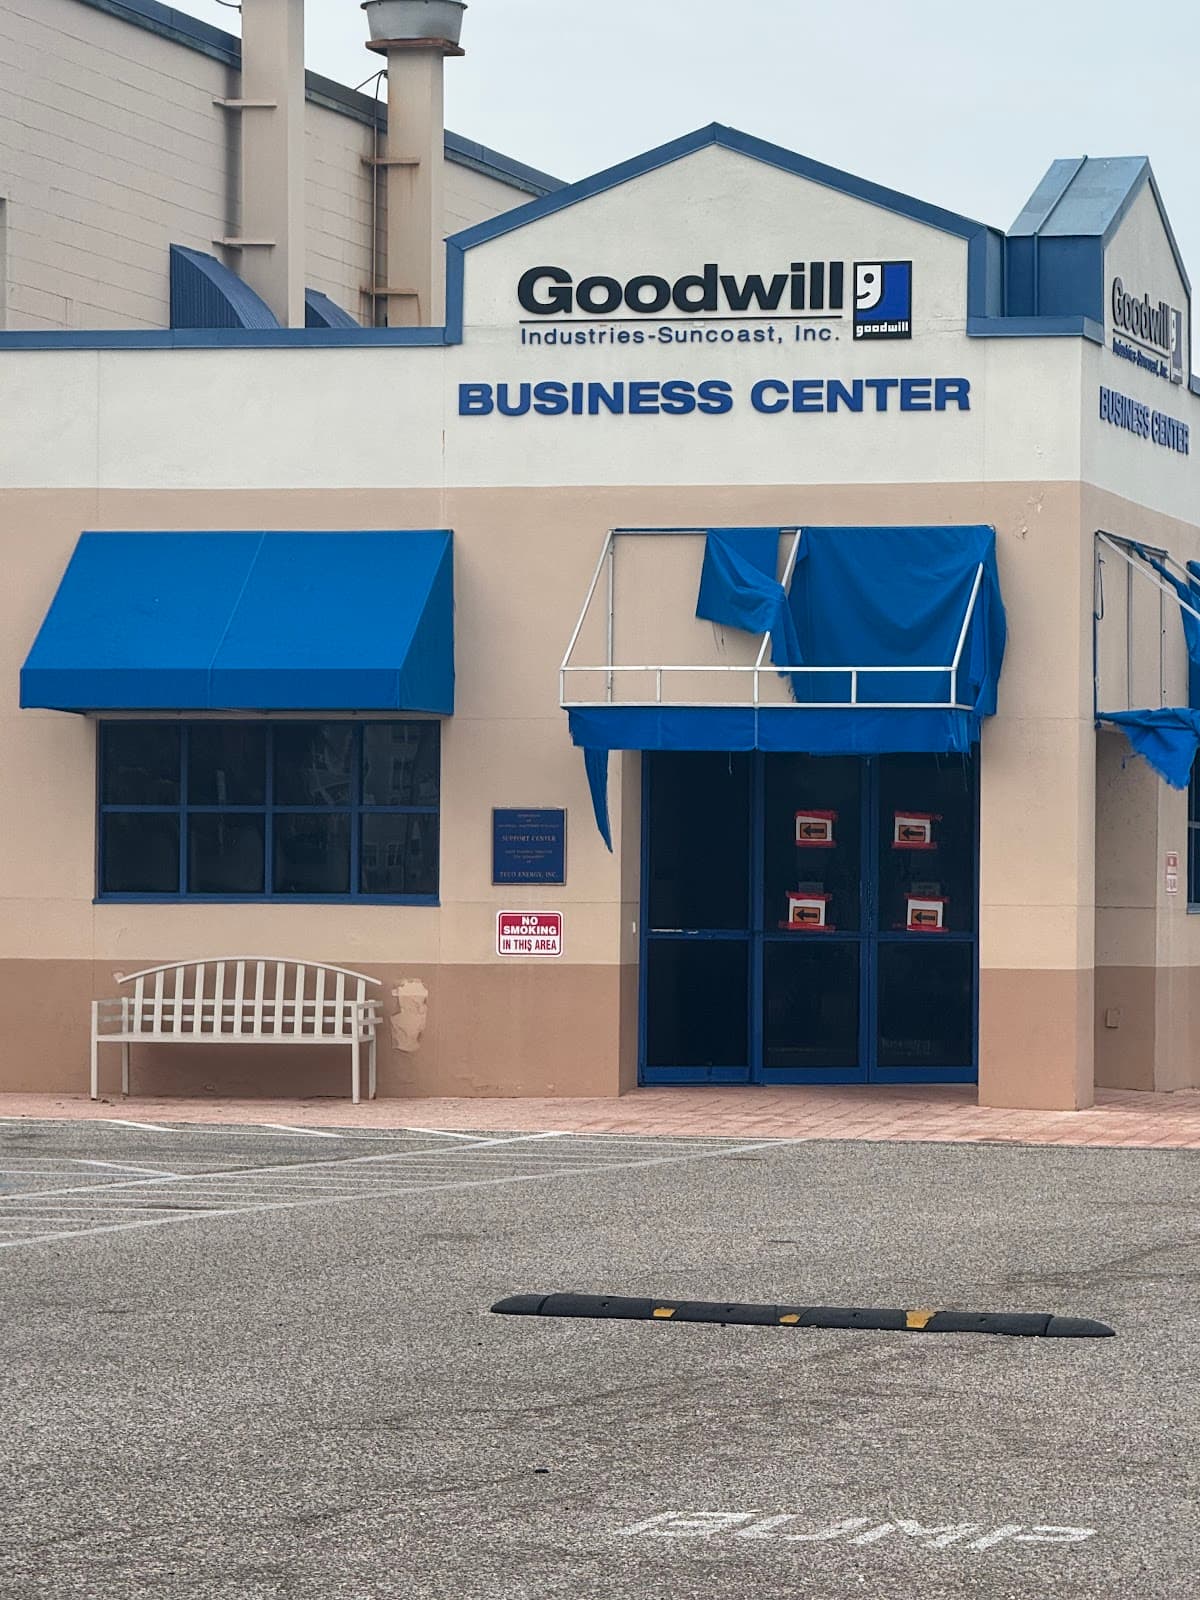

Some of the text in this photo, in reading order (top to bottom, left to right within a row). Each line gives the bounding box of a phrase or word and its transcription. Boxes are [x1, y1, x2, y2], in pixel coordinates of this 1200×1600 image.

[517, 261, 844, 314] Goodwill
[1112, 277, 1170, 350] Goodwill
[521, 324, 840, 345] Industries-Suncoast, Inc.
[856, 321, 909, 338] goodwill
[458, 377, 971, 416] BUSINESS CENTER
[1099, 385, 1190, 456] BUSINESS CENTER
[503, 925, 557, 935] SMOKING
[521, 916, 539, 926] NO
[502, 939, 557, 951] IN THIS AREA
[612, 1509, 1098, 1553] BUMP
